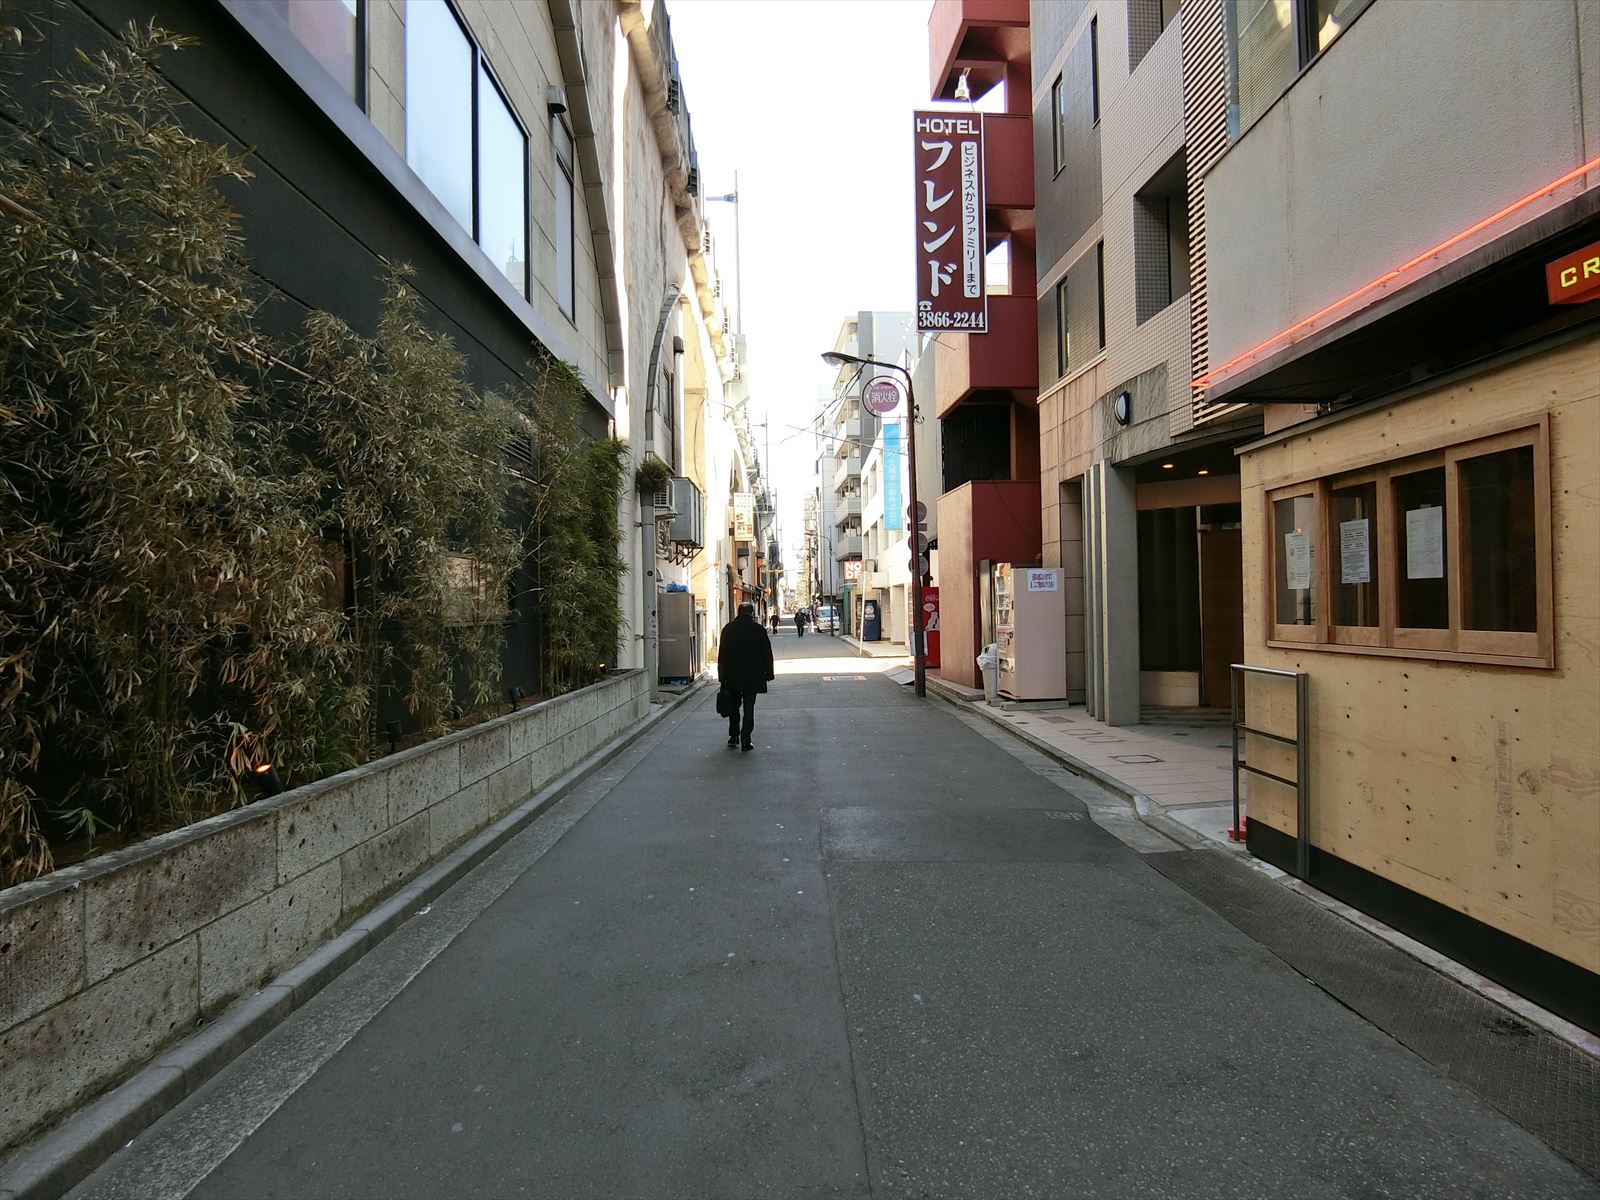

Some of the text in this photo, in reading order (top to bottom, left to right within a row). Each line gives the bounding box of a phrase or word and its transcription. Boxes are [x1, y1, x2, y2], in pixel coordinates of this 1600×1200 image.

[916, 118, 979, 134] HOTEL
[921, 140, 958, 298] フレンド
[964, 145, 976, 295] ビジネスからファミリーまで
[918, 311, 984, 328] 3866-2244
[871, 391, 897, 404] 消火栓
